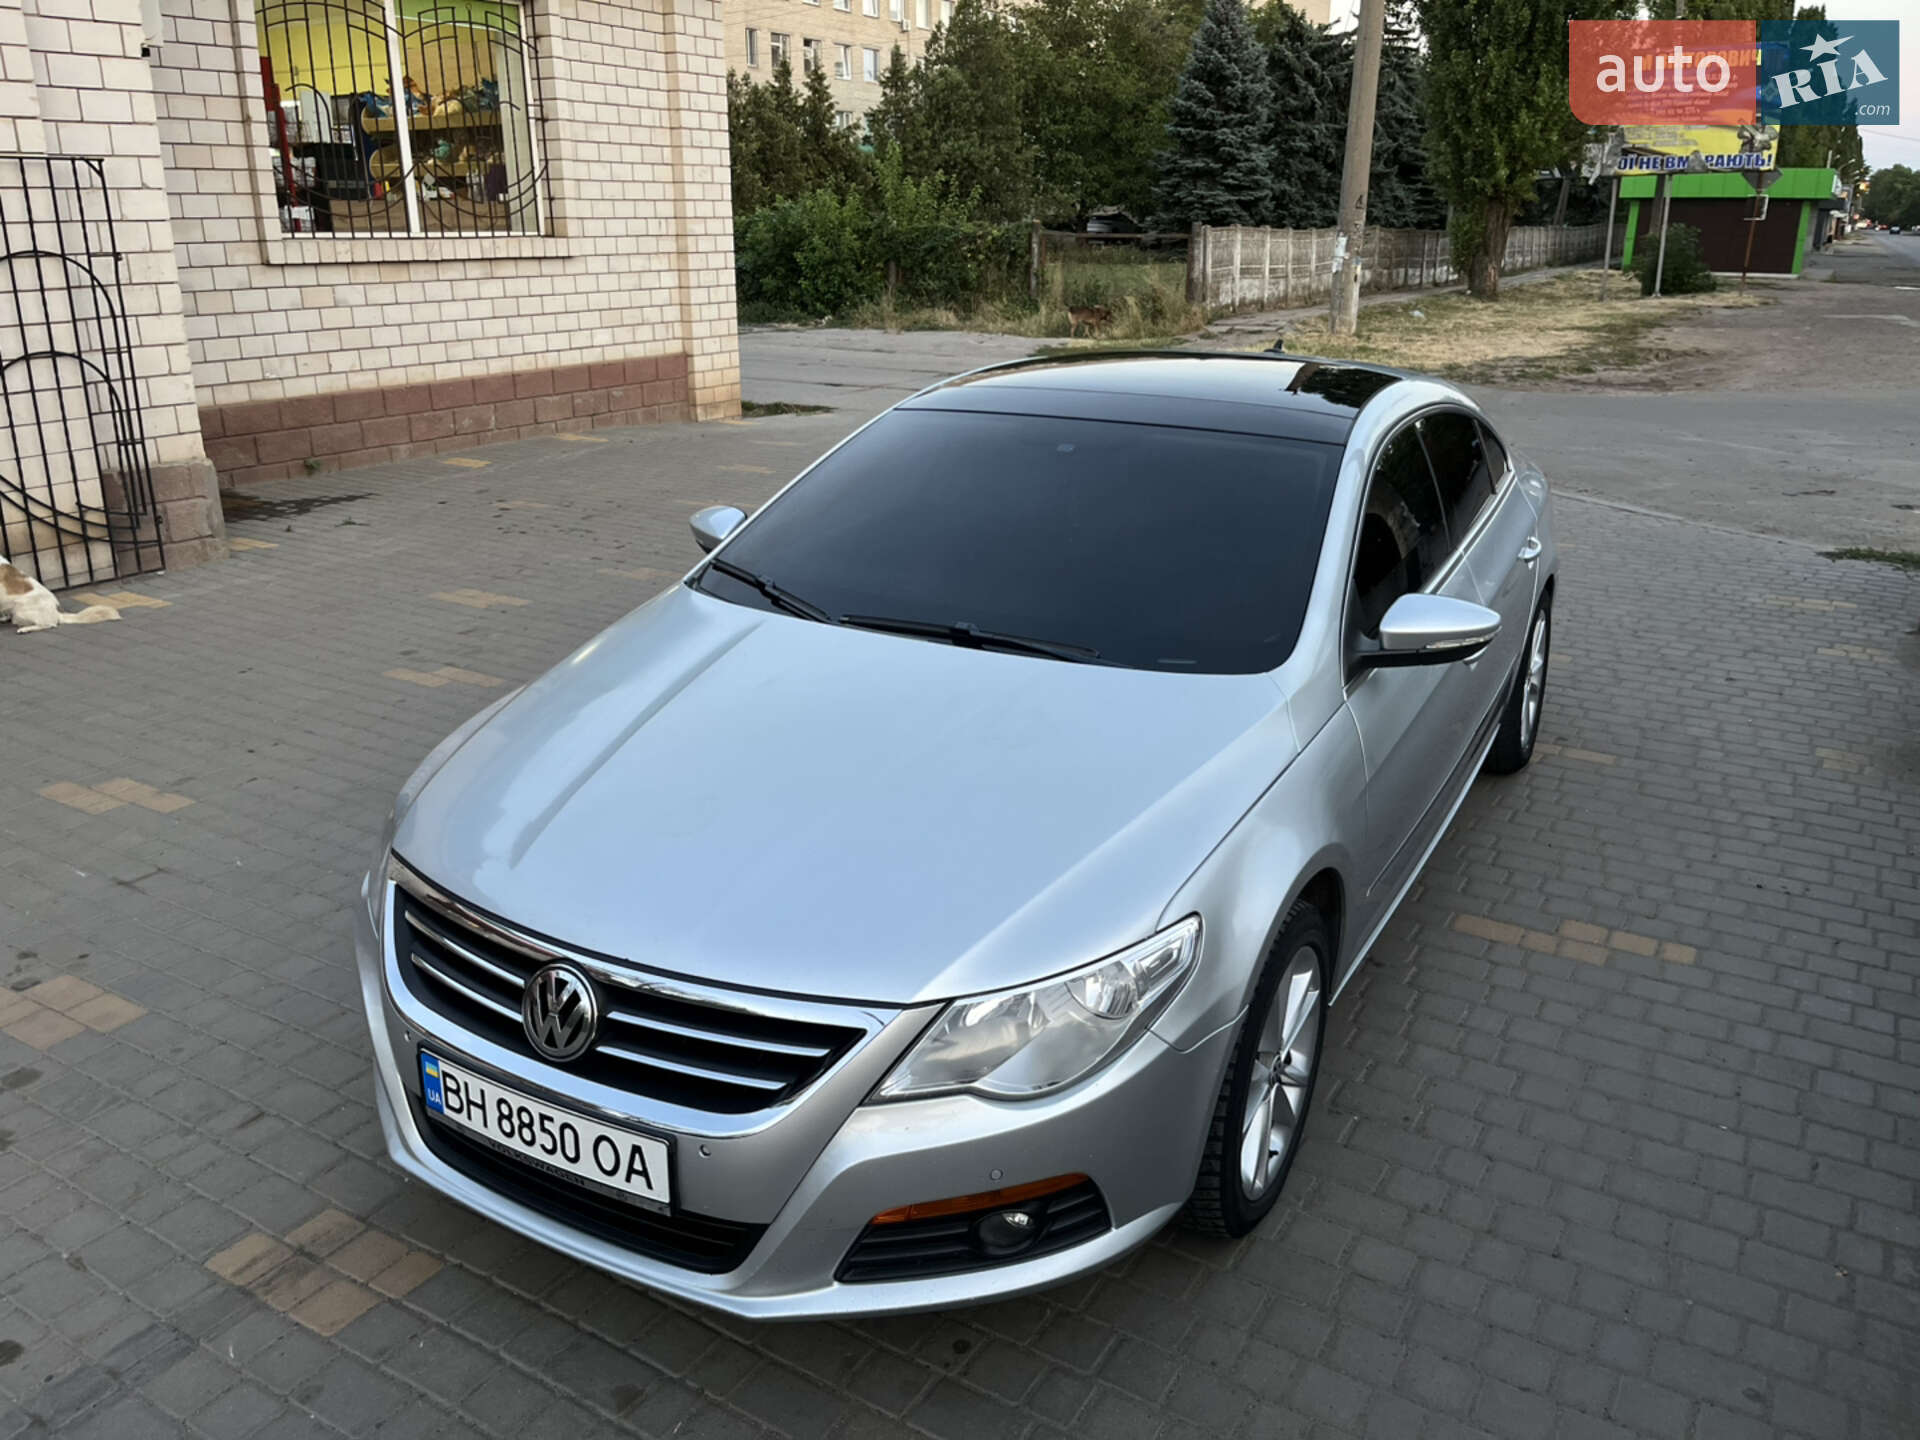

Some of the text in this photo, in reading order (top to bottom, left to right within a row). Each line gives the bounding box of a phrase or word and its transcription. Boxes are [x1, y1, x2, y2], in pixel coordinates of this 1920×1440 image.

[1618, 152, 1772, 171] ОЇ НЕ ВМРАЮТЬ!
[427, 1088, 442, 1105] UA
[496, 1097, 581, 1164] 8850
